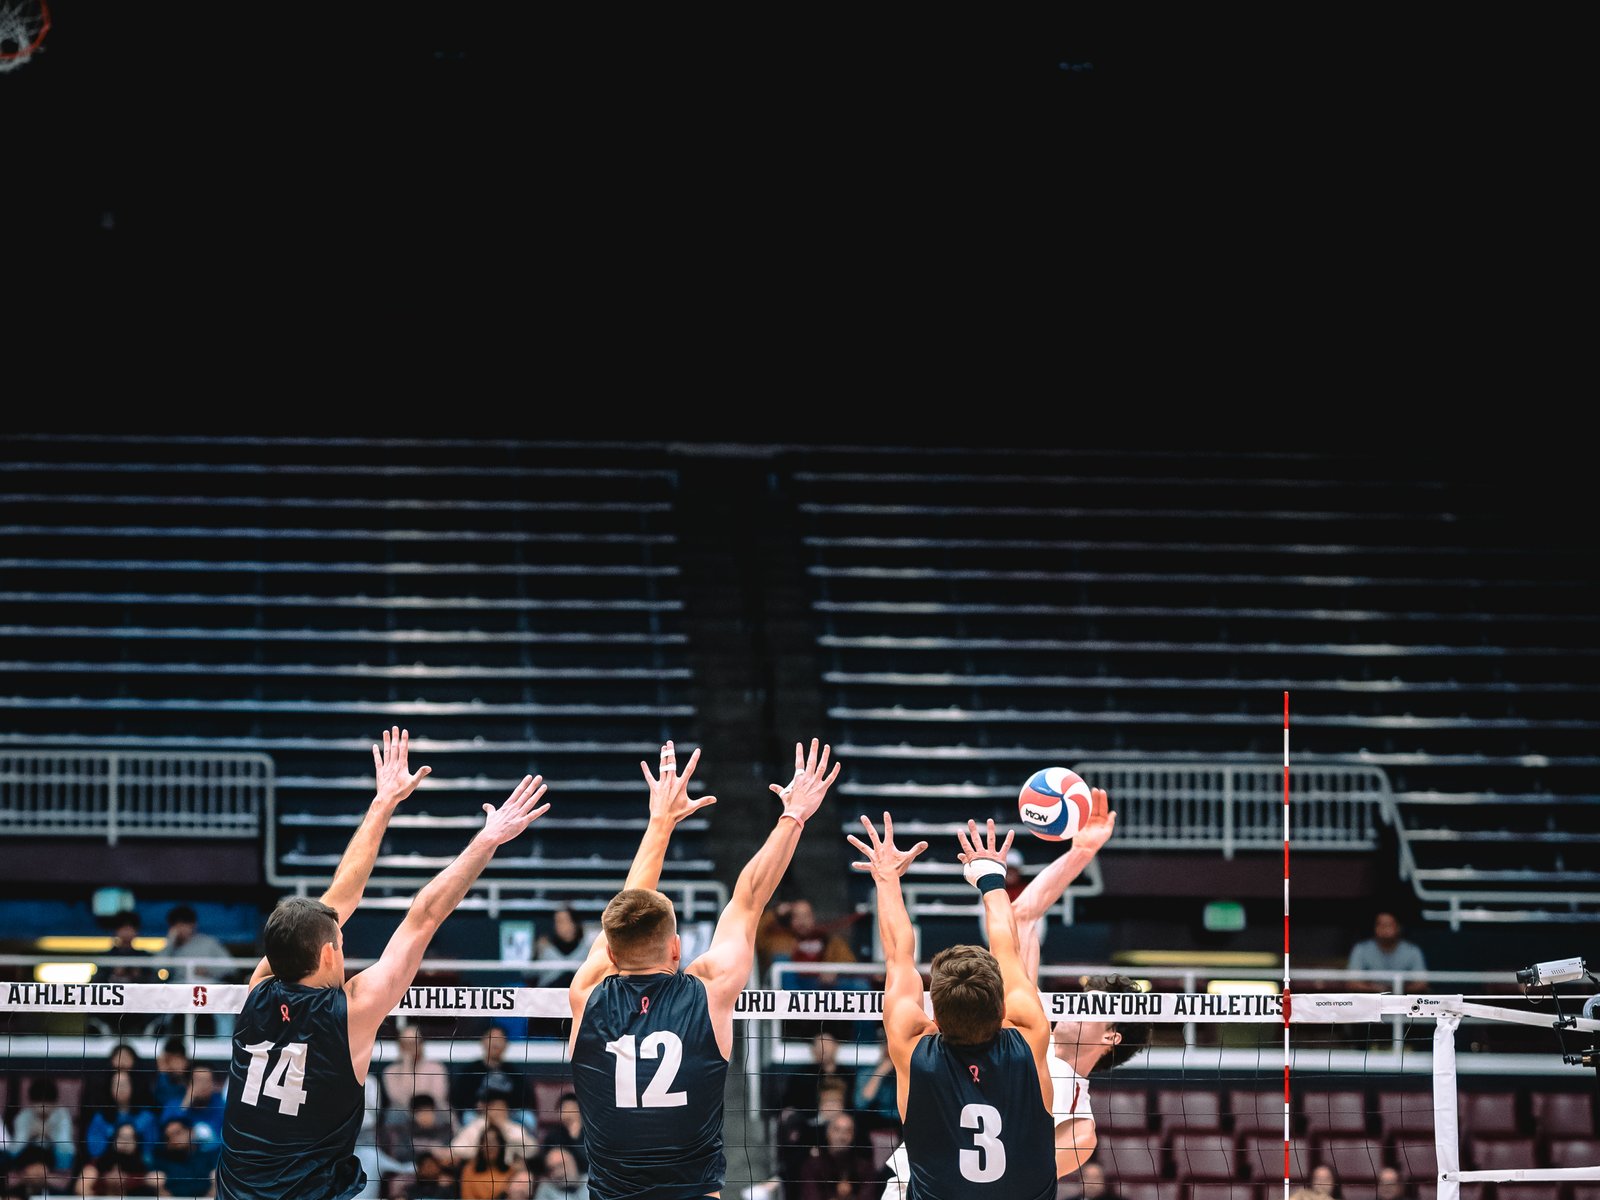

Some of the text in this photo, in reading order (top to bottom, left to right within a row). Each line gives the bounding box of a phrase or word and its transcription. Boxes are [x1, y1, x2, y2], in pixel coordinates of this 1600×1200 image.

[1025, 808, 1048, 823] NCAA
[8, 984, 125, 1006] ATHLETICS
[399, 988, 515, 1010] ATHLETICS
[787, 991, 885, 1013] ATHLETIC
[1052, 993, 1283, 1016] STANFORD ATHLETICS
[241, 1040, 308, 1117] 14
[605, 1030, 688, 1108] 12
[959, 1103, 1006, 1184] 3
